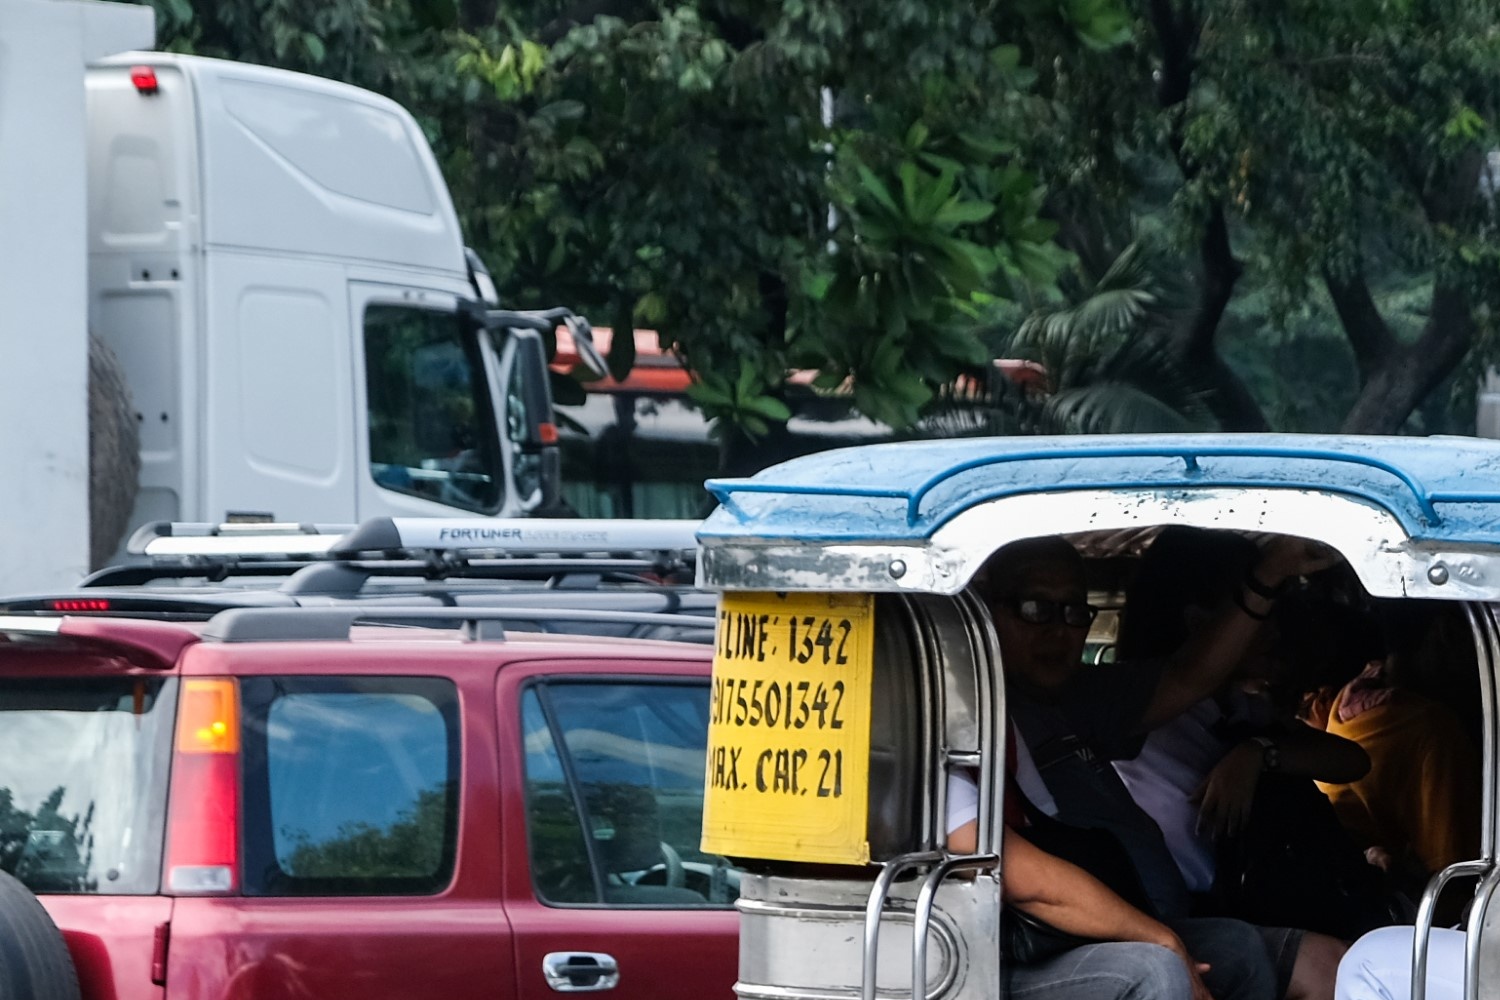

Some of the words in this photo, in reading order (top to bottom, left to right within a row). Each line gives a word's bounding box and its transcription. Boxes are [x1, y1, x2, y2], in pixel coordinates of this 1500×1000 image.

[440, 527, 522, 541] FORTUNER
[789, 615, 852, 665] 1342
[755, 747, 808, 796] CAP.
[817, 748, 843, 798] 21
